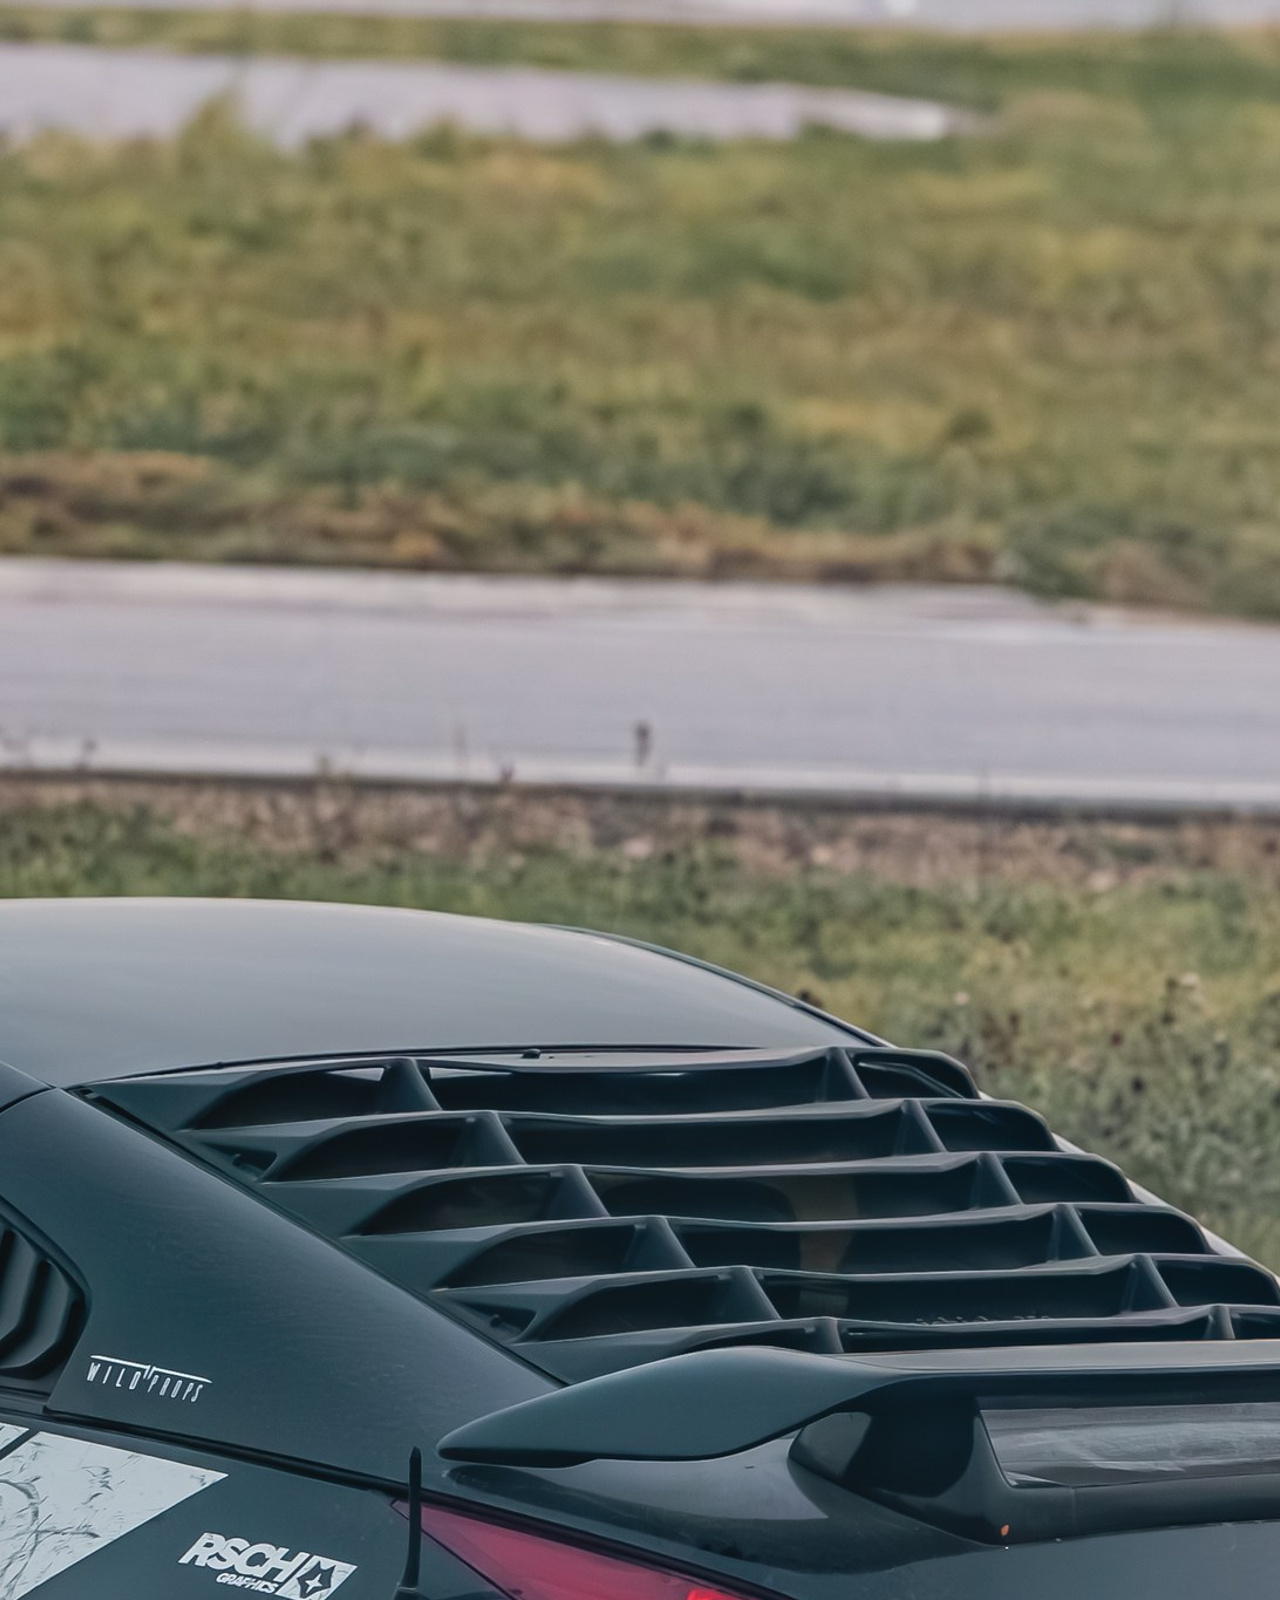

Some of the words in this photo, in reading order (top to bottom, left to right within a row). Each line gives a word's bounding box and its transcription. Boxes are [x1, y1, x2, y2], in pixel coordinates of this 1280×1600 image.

[86, 1361, 142, 1390] WILD
[178, 1532, 310, 1583] RSCH
[216, 1572, 281, 1595] GRAPHICS
